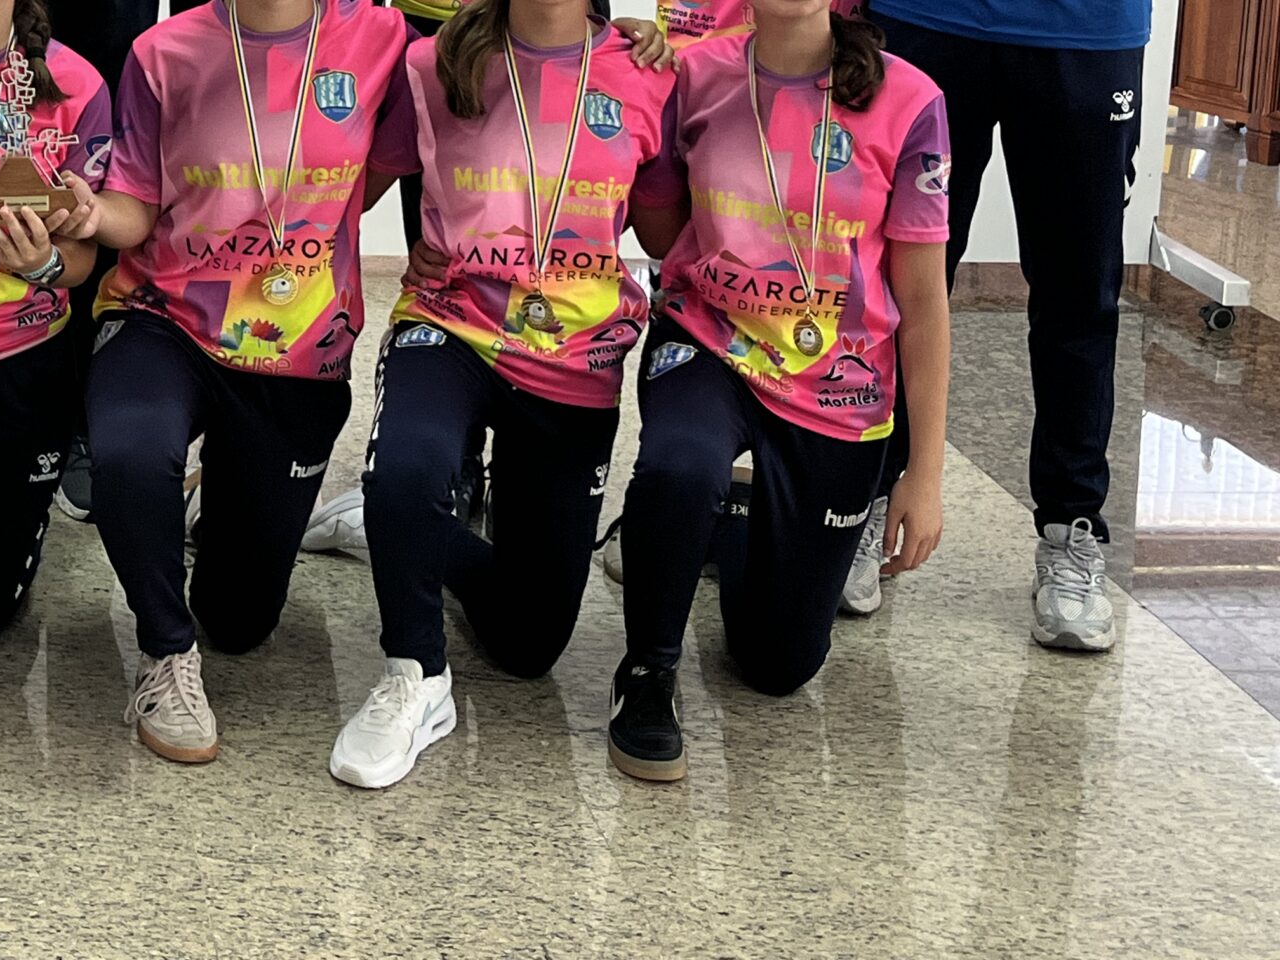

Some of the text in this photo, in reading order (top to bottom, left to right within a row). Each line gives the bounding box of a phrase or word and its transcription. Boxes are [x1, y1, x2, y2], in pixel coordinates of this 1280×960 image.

[657, 5, 687, 18] Centros
[688, 11, 699, 20] de
[817, 393, 879, 408] Morales
